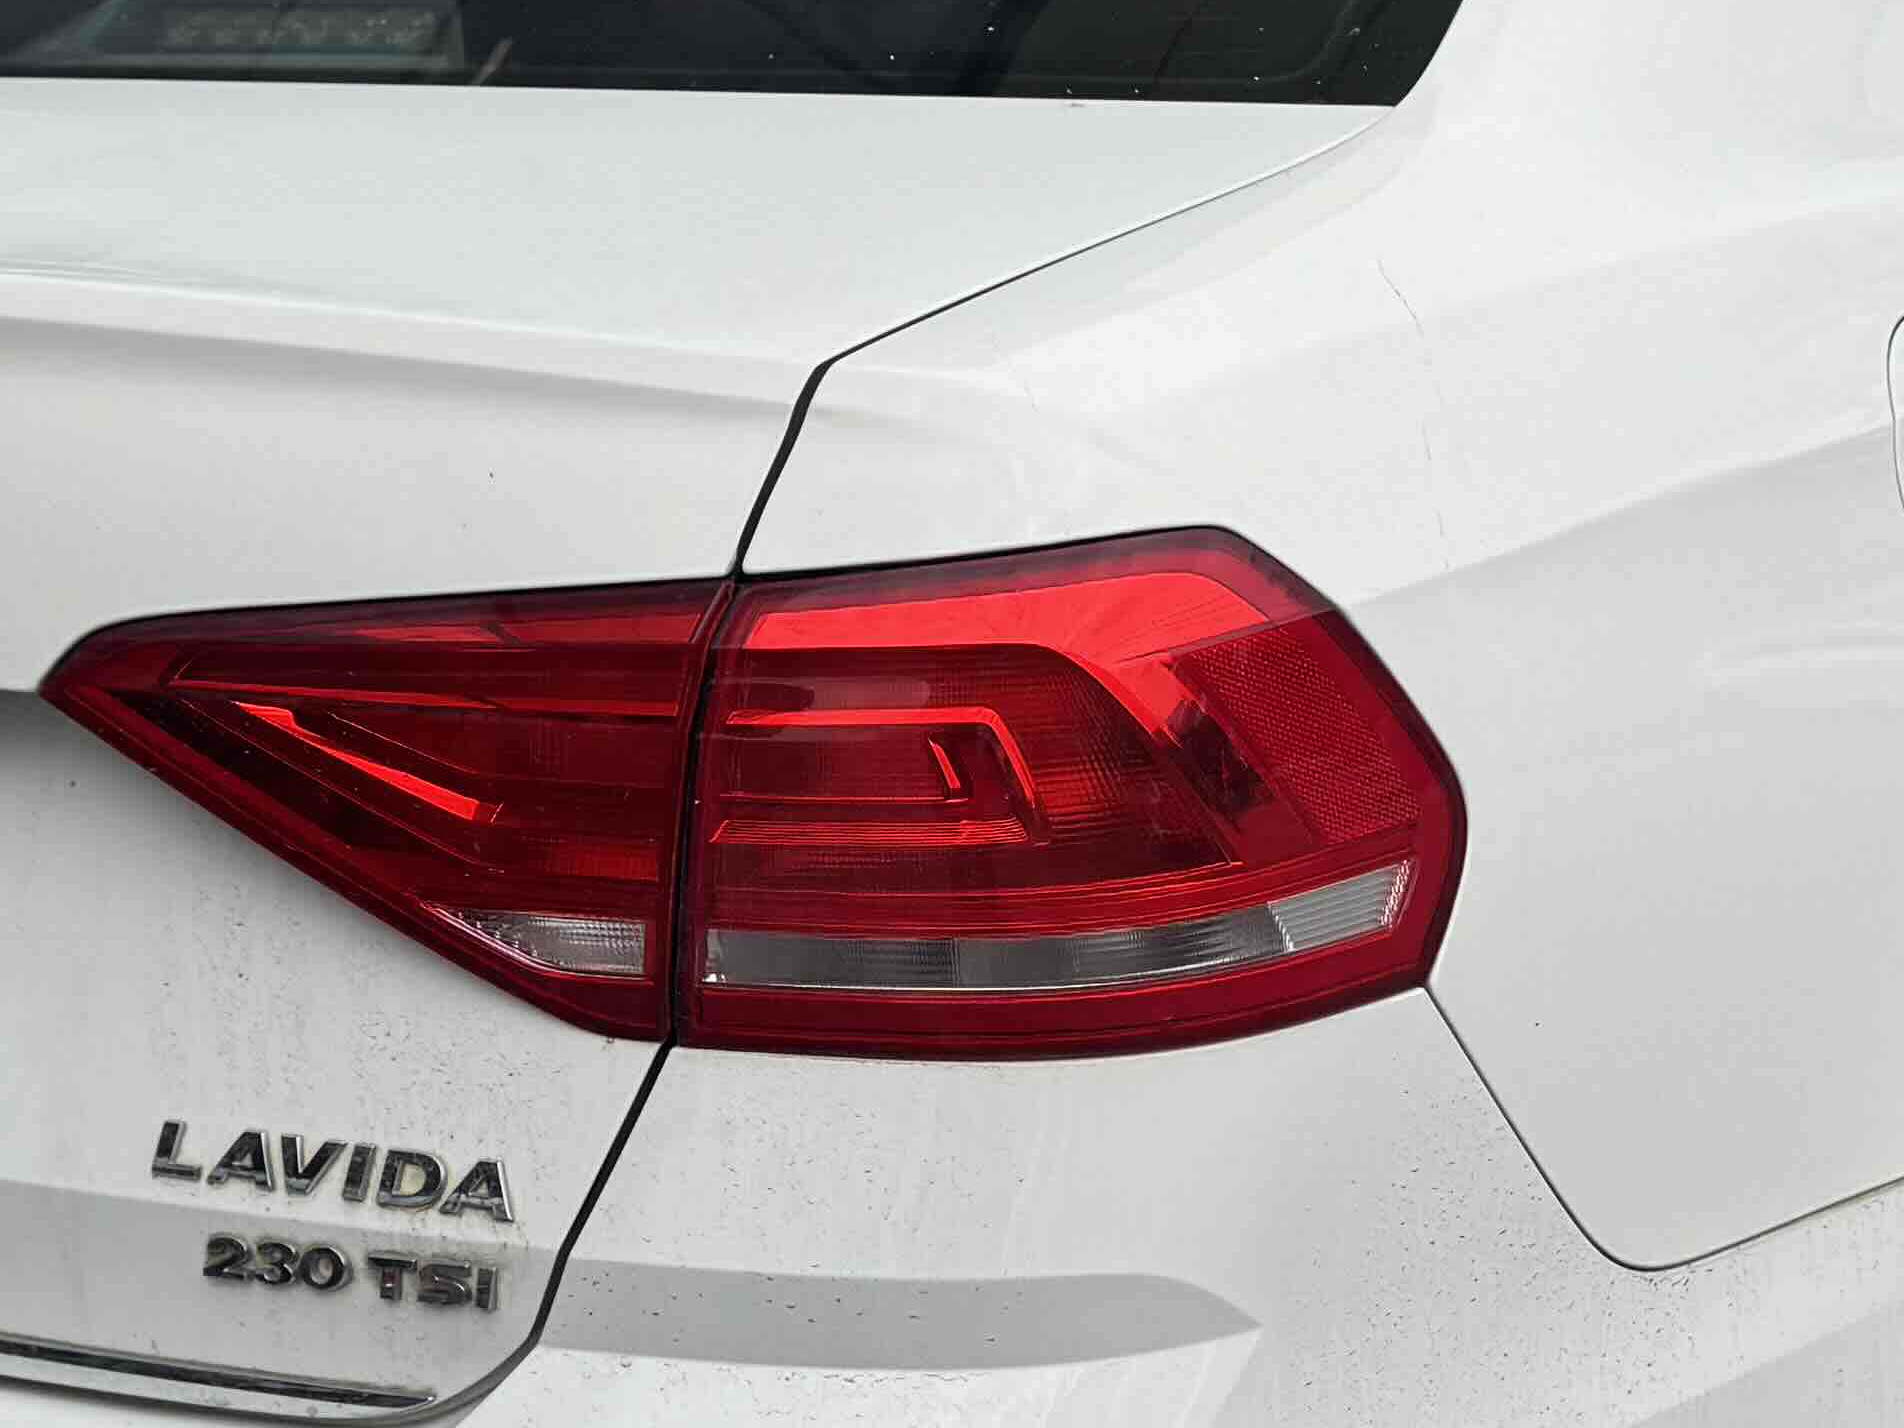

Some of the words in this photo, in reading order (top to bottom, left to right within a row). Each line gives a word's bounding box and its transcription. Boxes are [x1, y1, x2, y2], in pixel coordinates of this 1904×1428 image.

[151, 1117, 515, 1224] LAVIDA
[202, 1231, 354, 1292] 230
[367, 1251, 502, 1313] TSI
